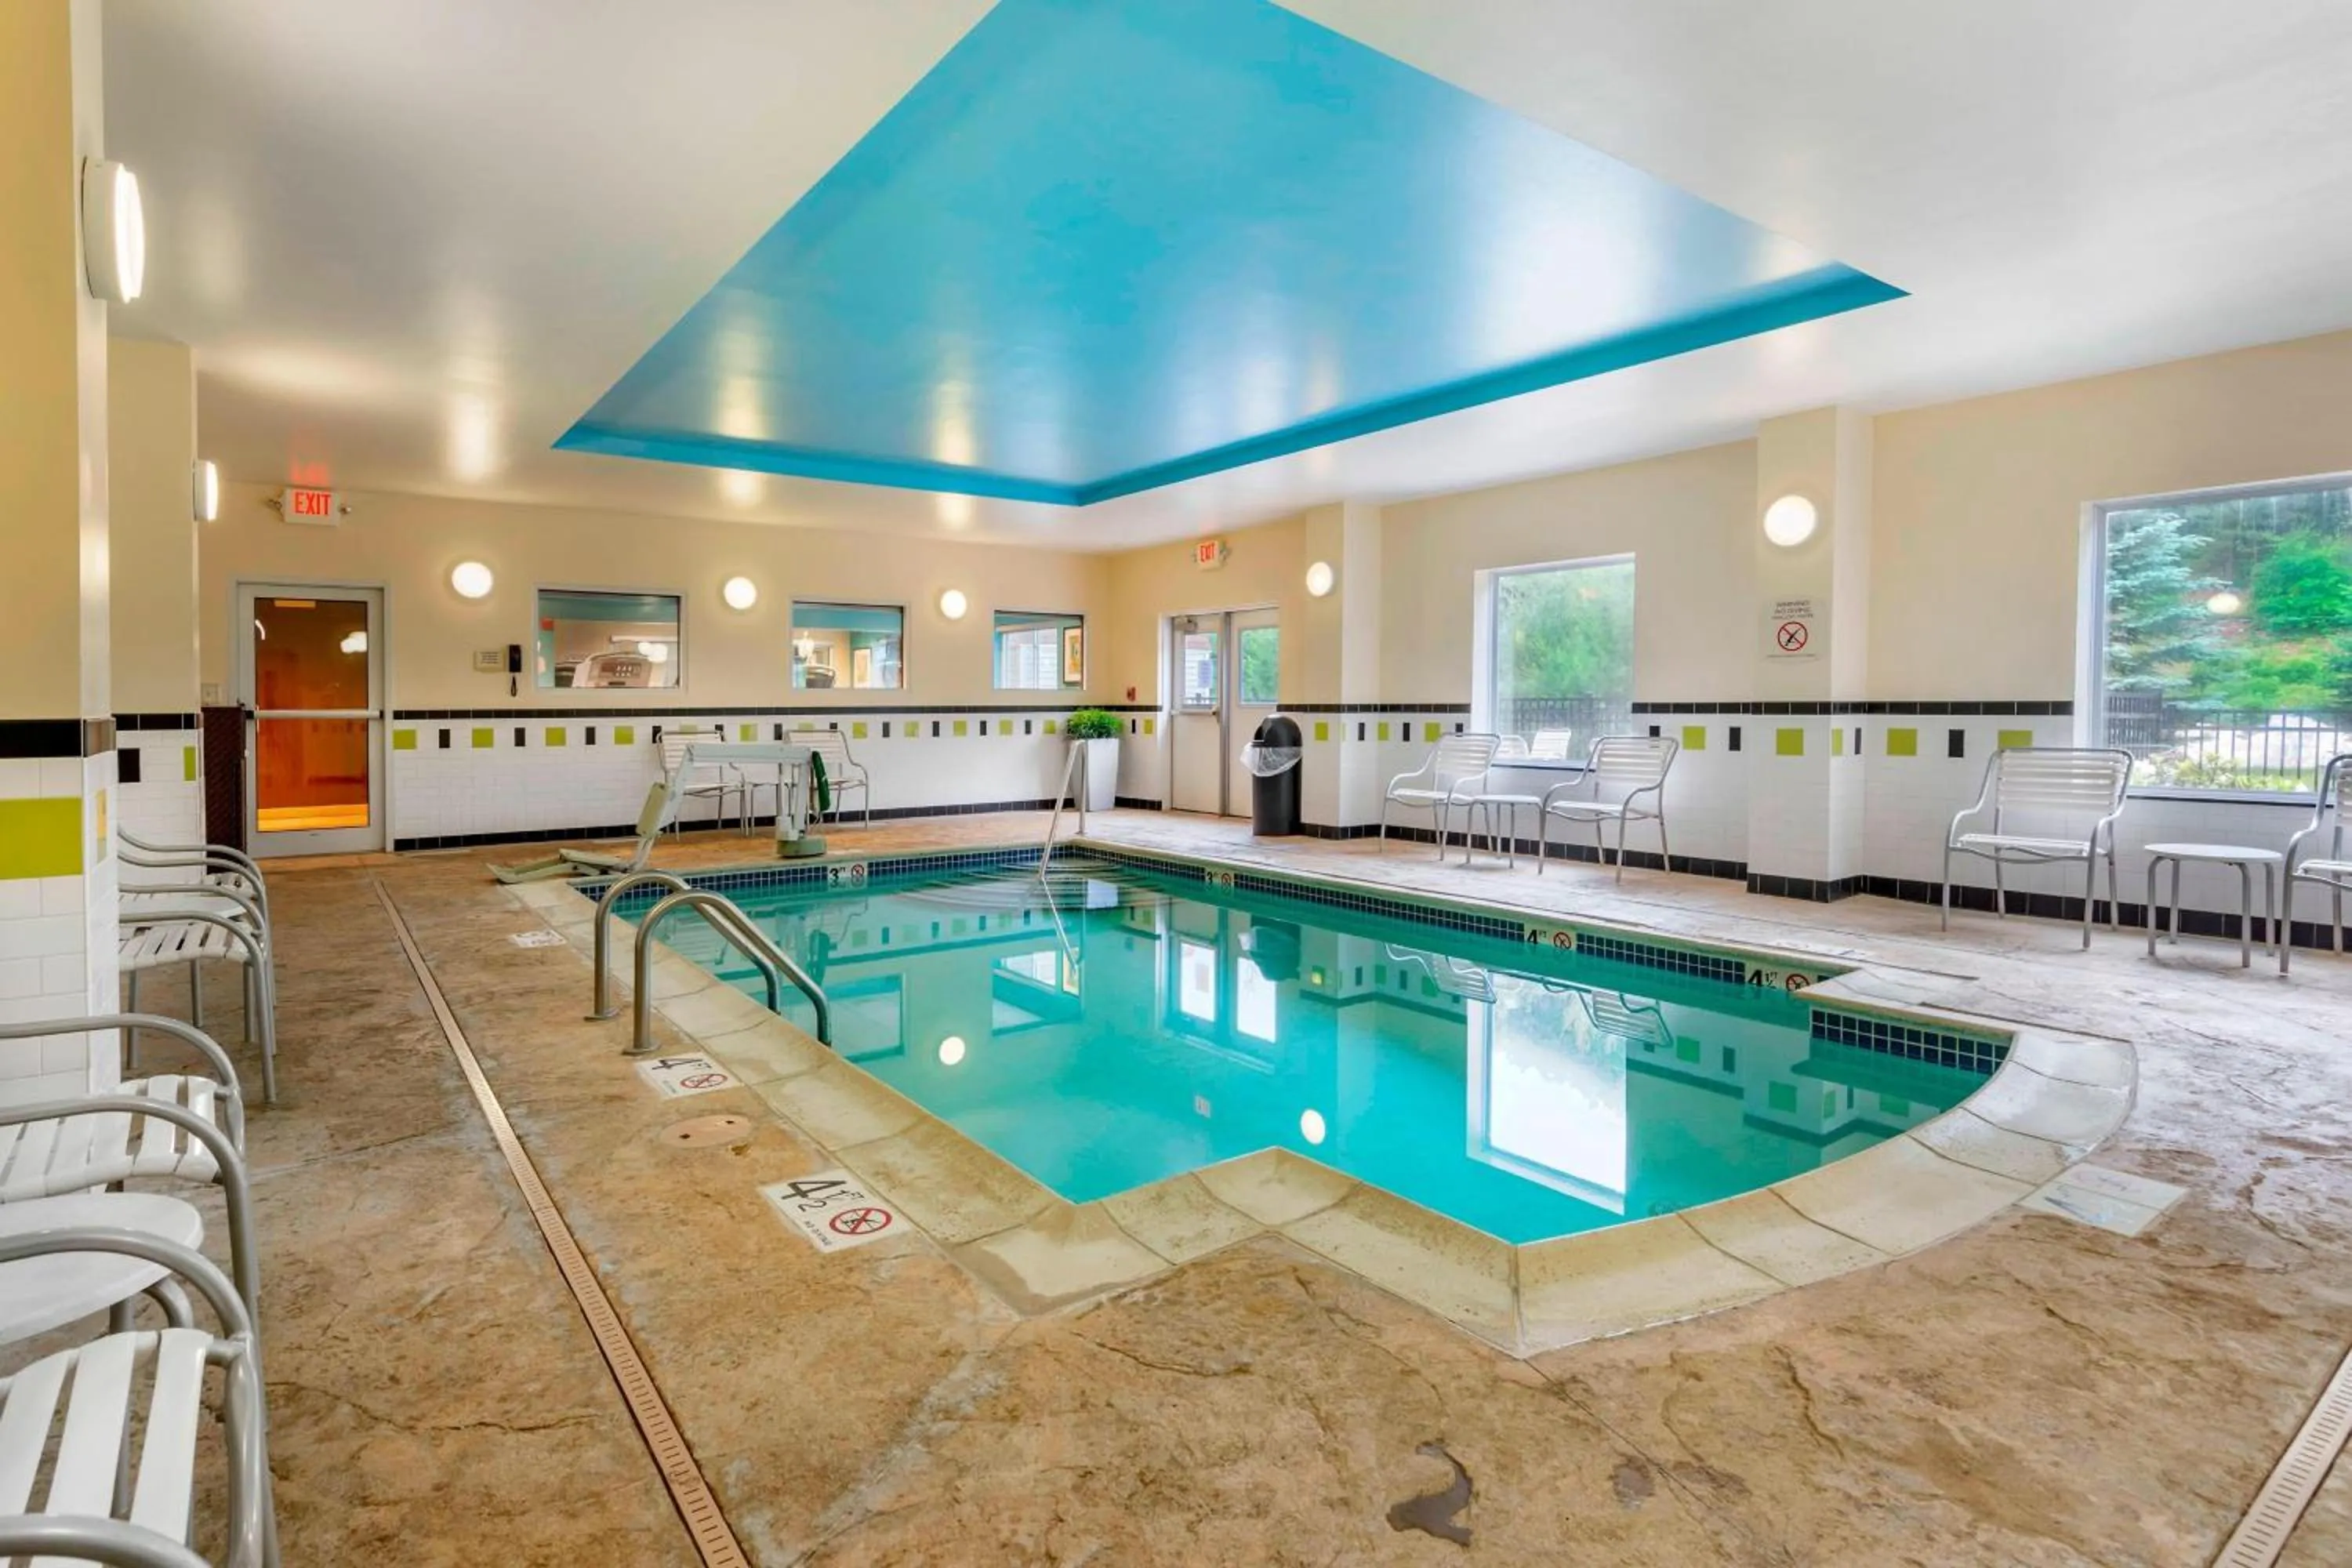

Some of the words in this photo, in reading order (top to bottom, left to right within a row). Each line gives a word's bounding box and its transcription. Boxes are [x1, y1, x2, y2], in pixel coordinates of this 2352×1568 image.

[295, 492, 331, 515] EXIT
[829, 868, 839, 882] 3
[1527, 930, 1537, 944] 4
